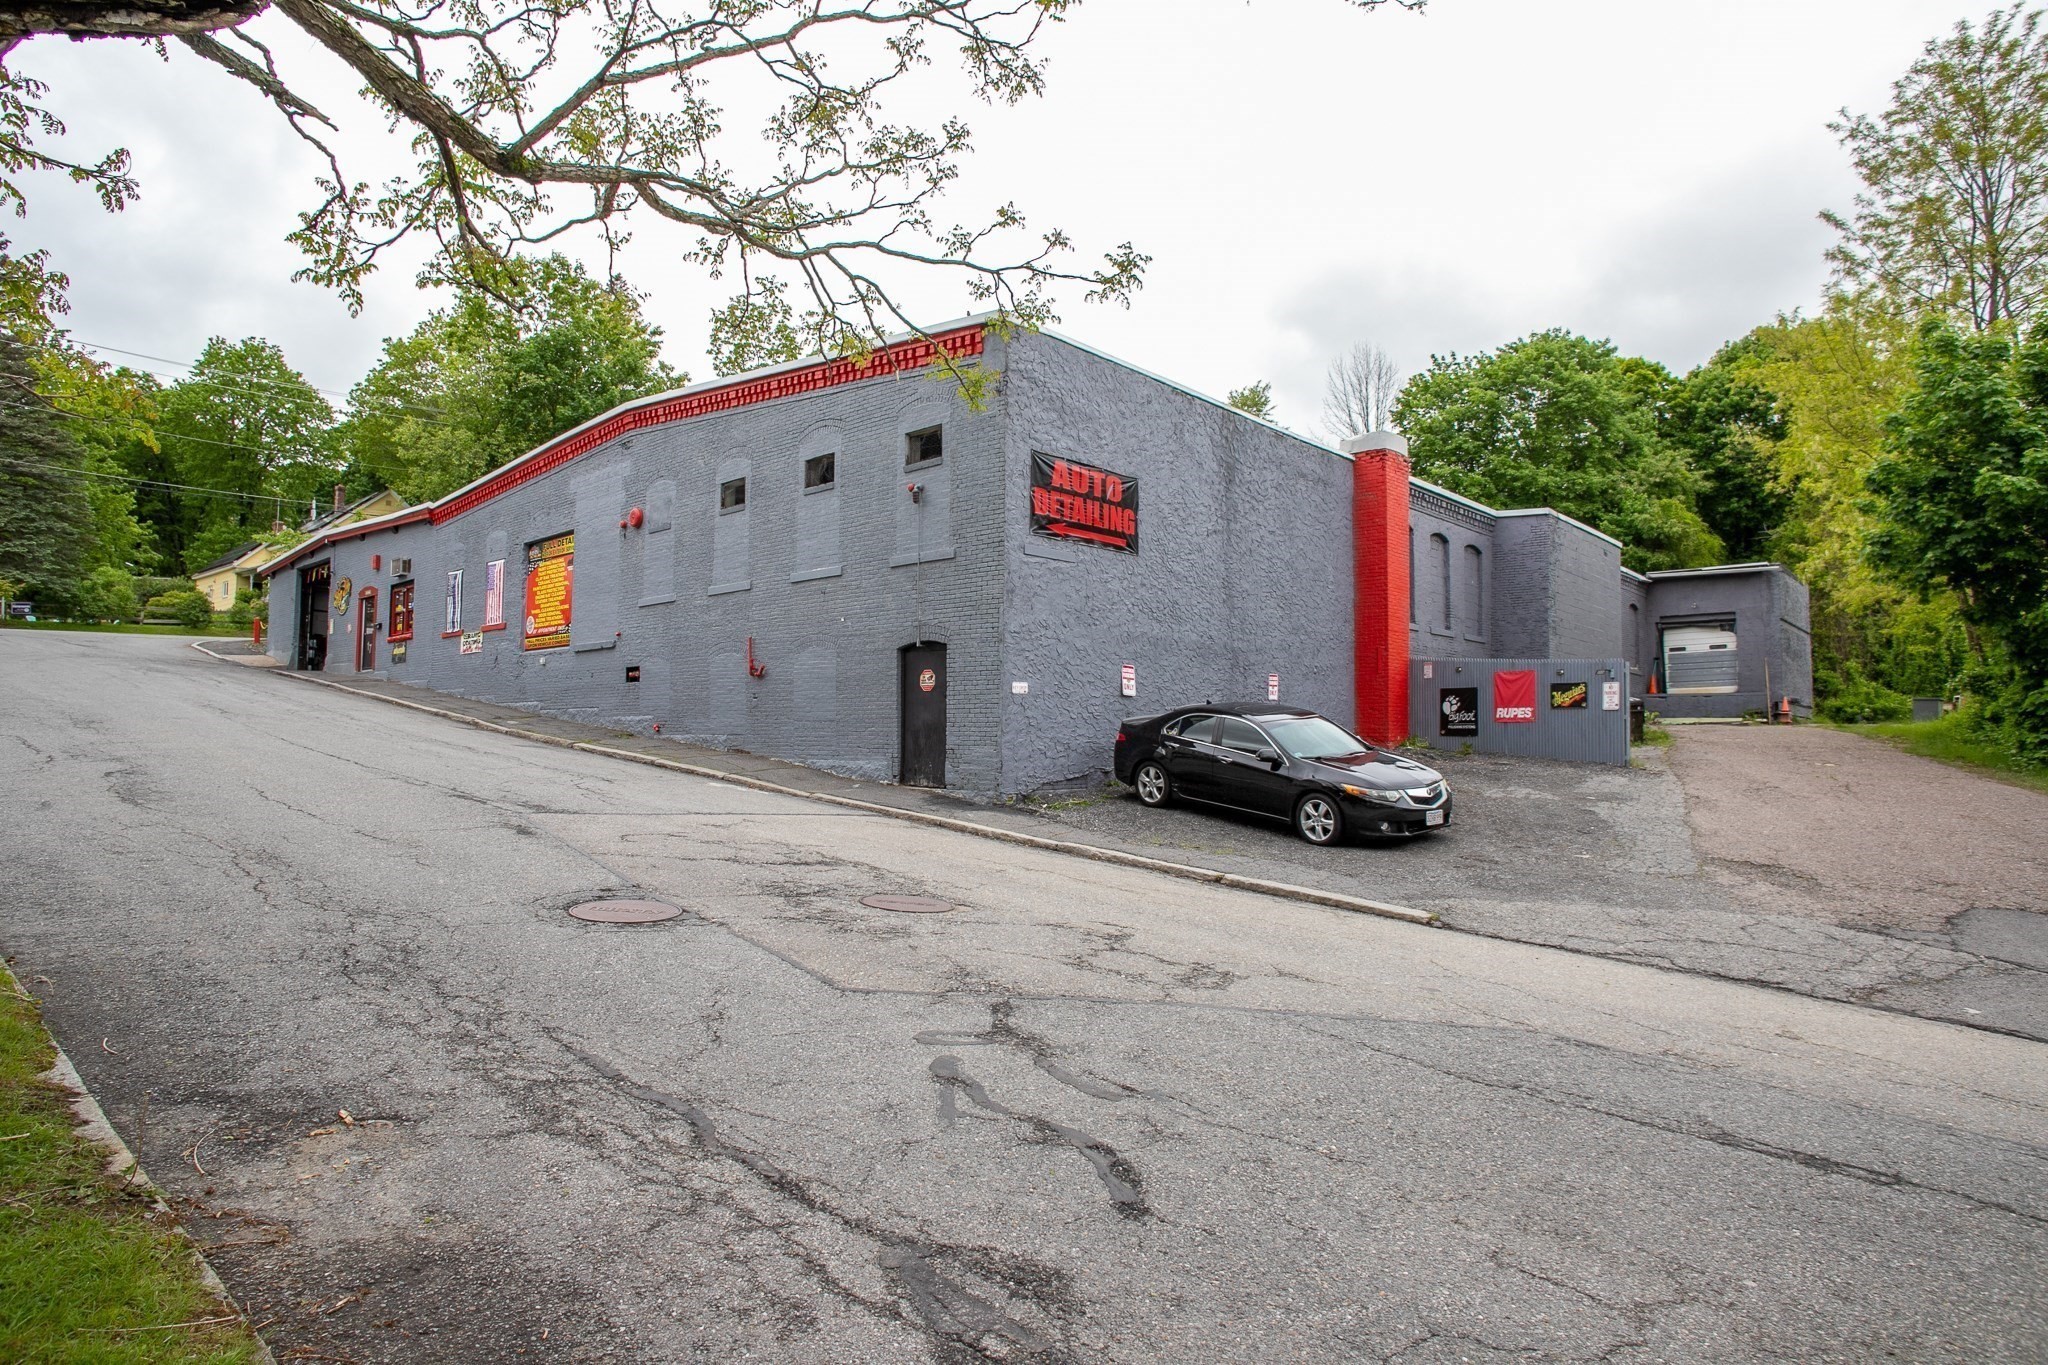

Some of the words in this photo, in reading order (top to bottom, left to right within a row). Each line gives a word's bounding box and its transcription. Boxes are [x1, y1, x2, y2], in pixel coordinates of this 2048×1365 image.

[1051, 458, 1122, 502] AUTO
[1032, 486, 1135, 535] DETAILING
[1496, 707, 1532, 718] RUPES
